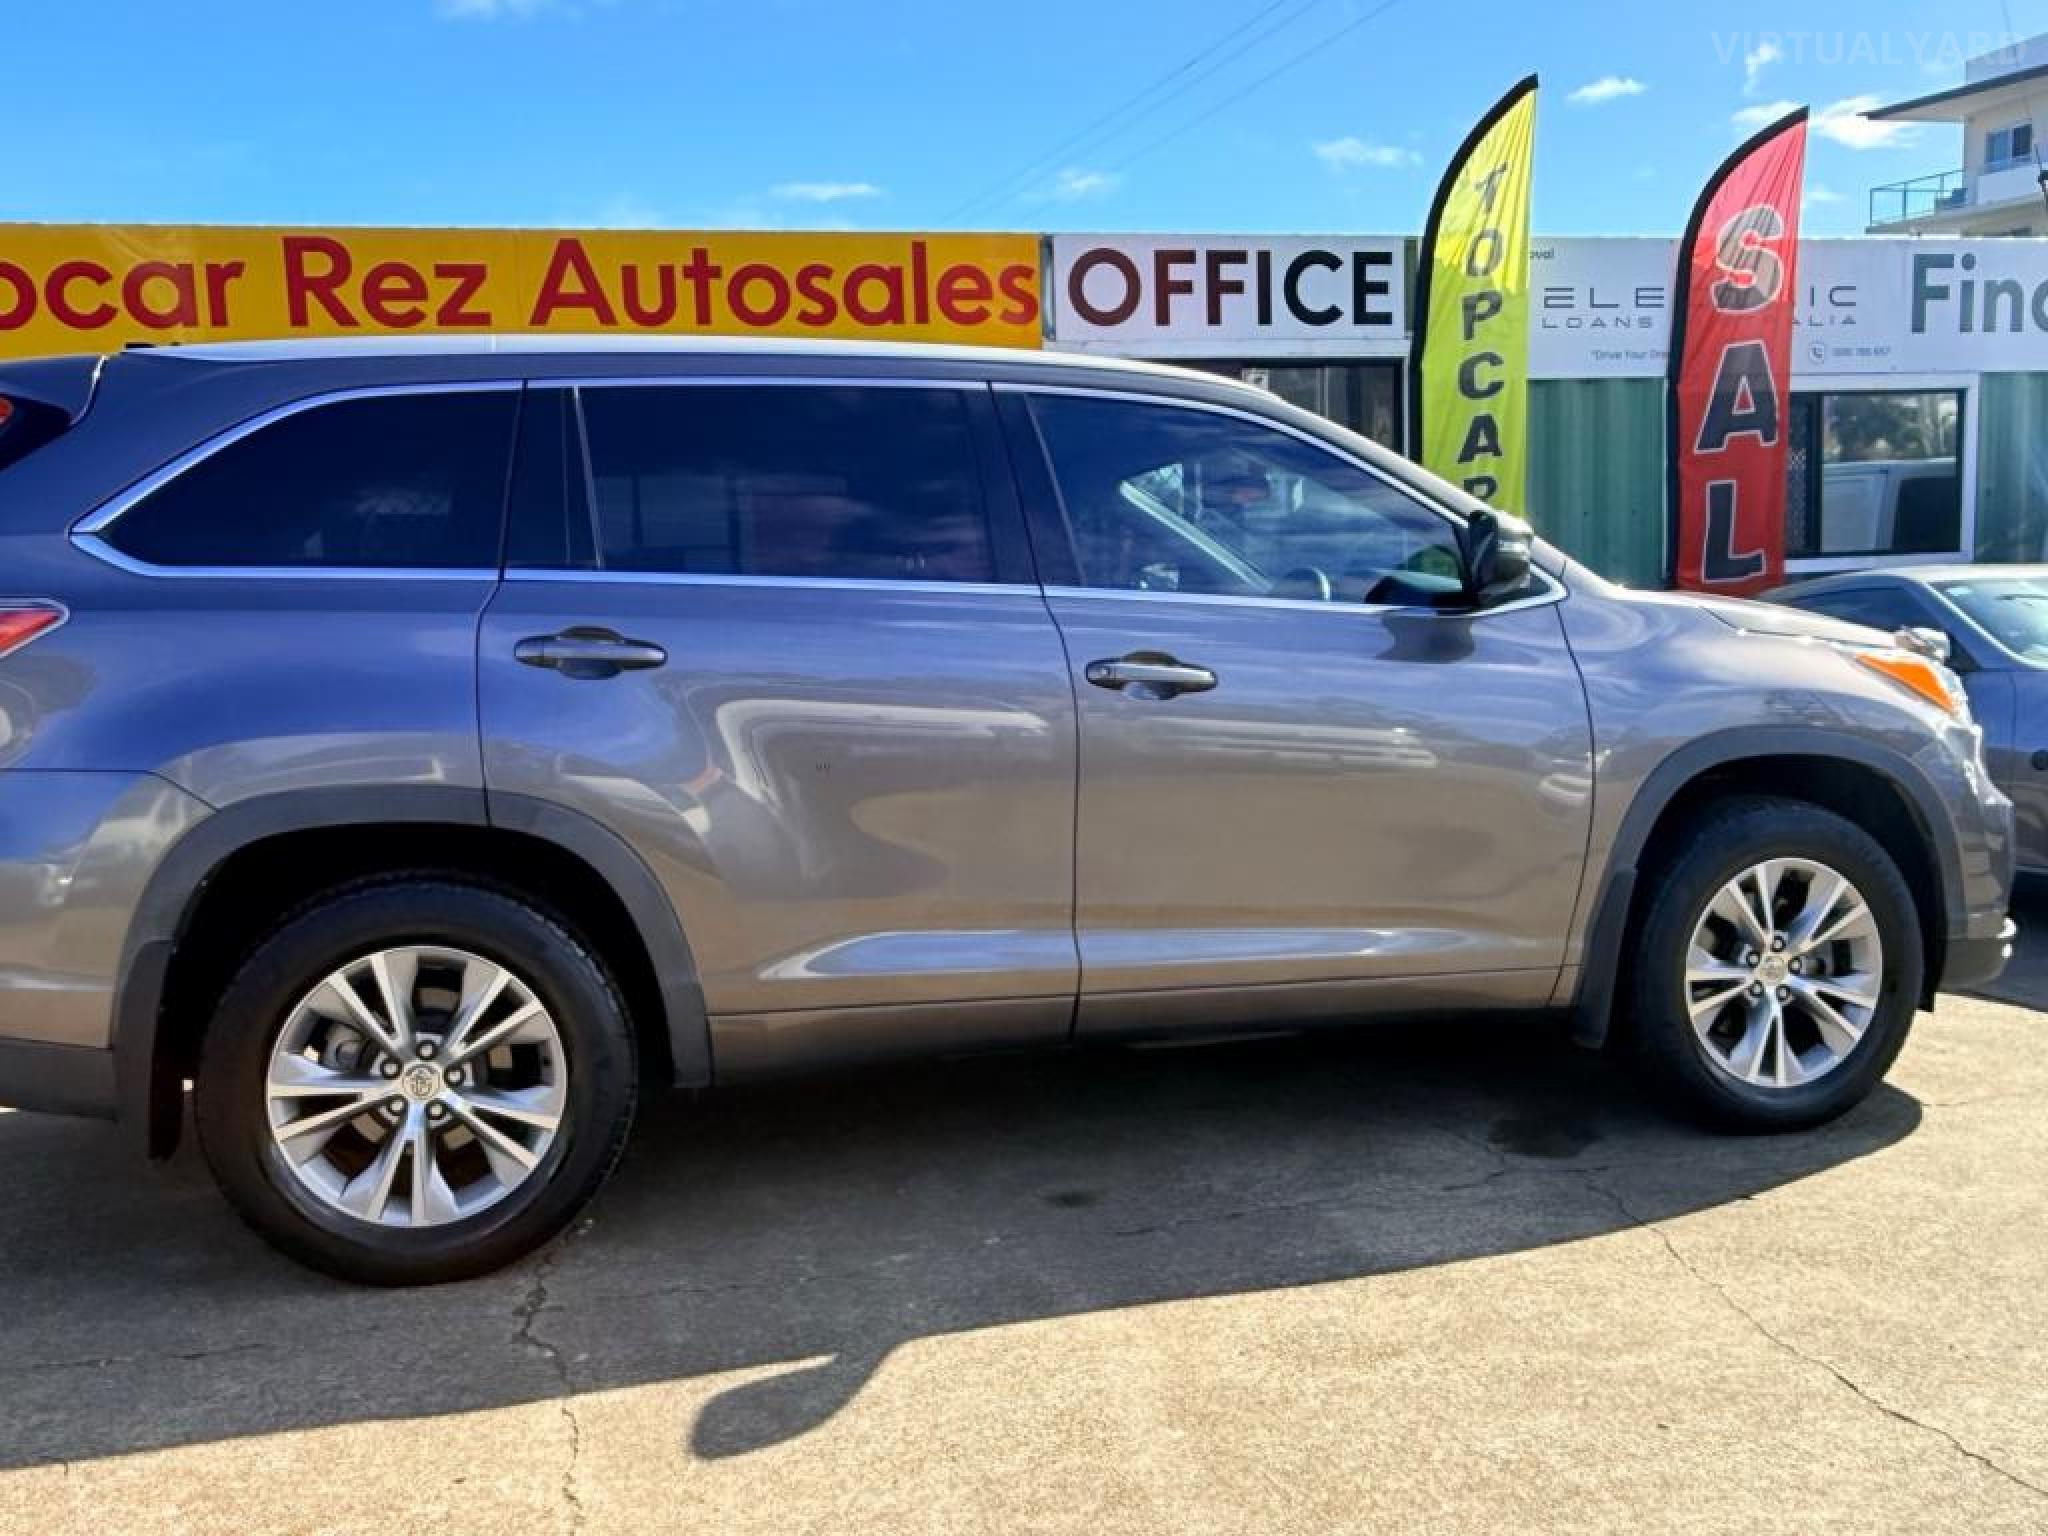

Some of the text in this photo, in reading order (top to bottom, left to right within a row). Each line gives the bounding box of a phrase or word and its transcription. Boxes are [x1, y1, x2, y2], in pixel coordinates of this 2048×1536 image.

[282, 235, 493, 328] Rez
[528, 237, 1039, 327] Autosales
[1067, 247, 1393, 327] OFFICE
[1541, 317, 1654, 329] LOANS
